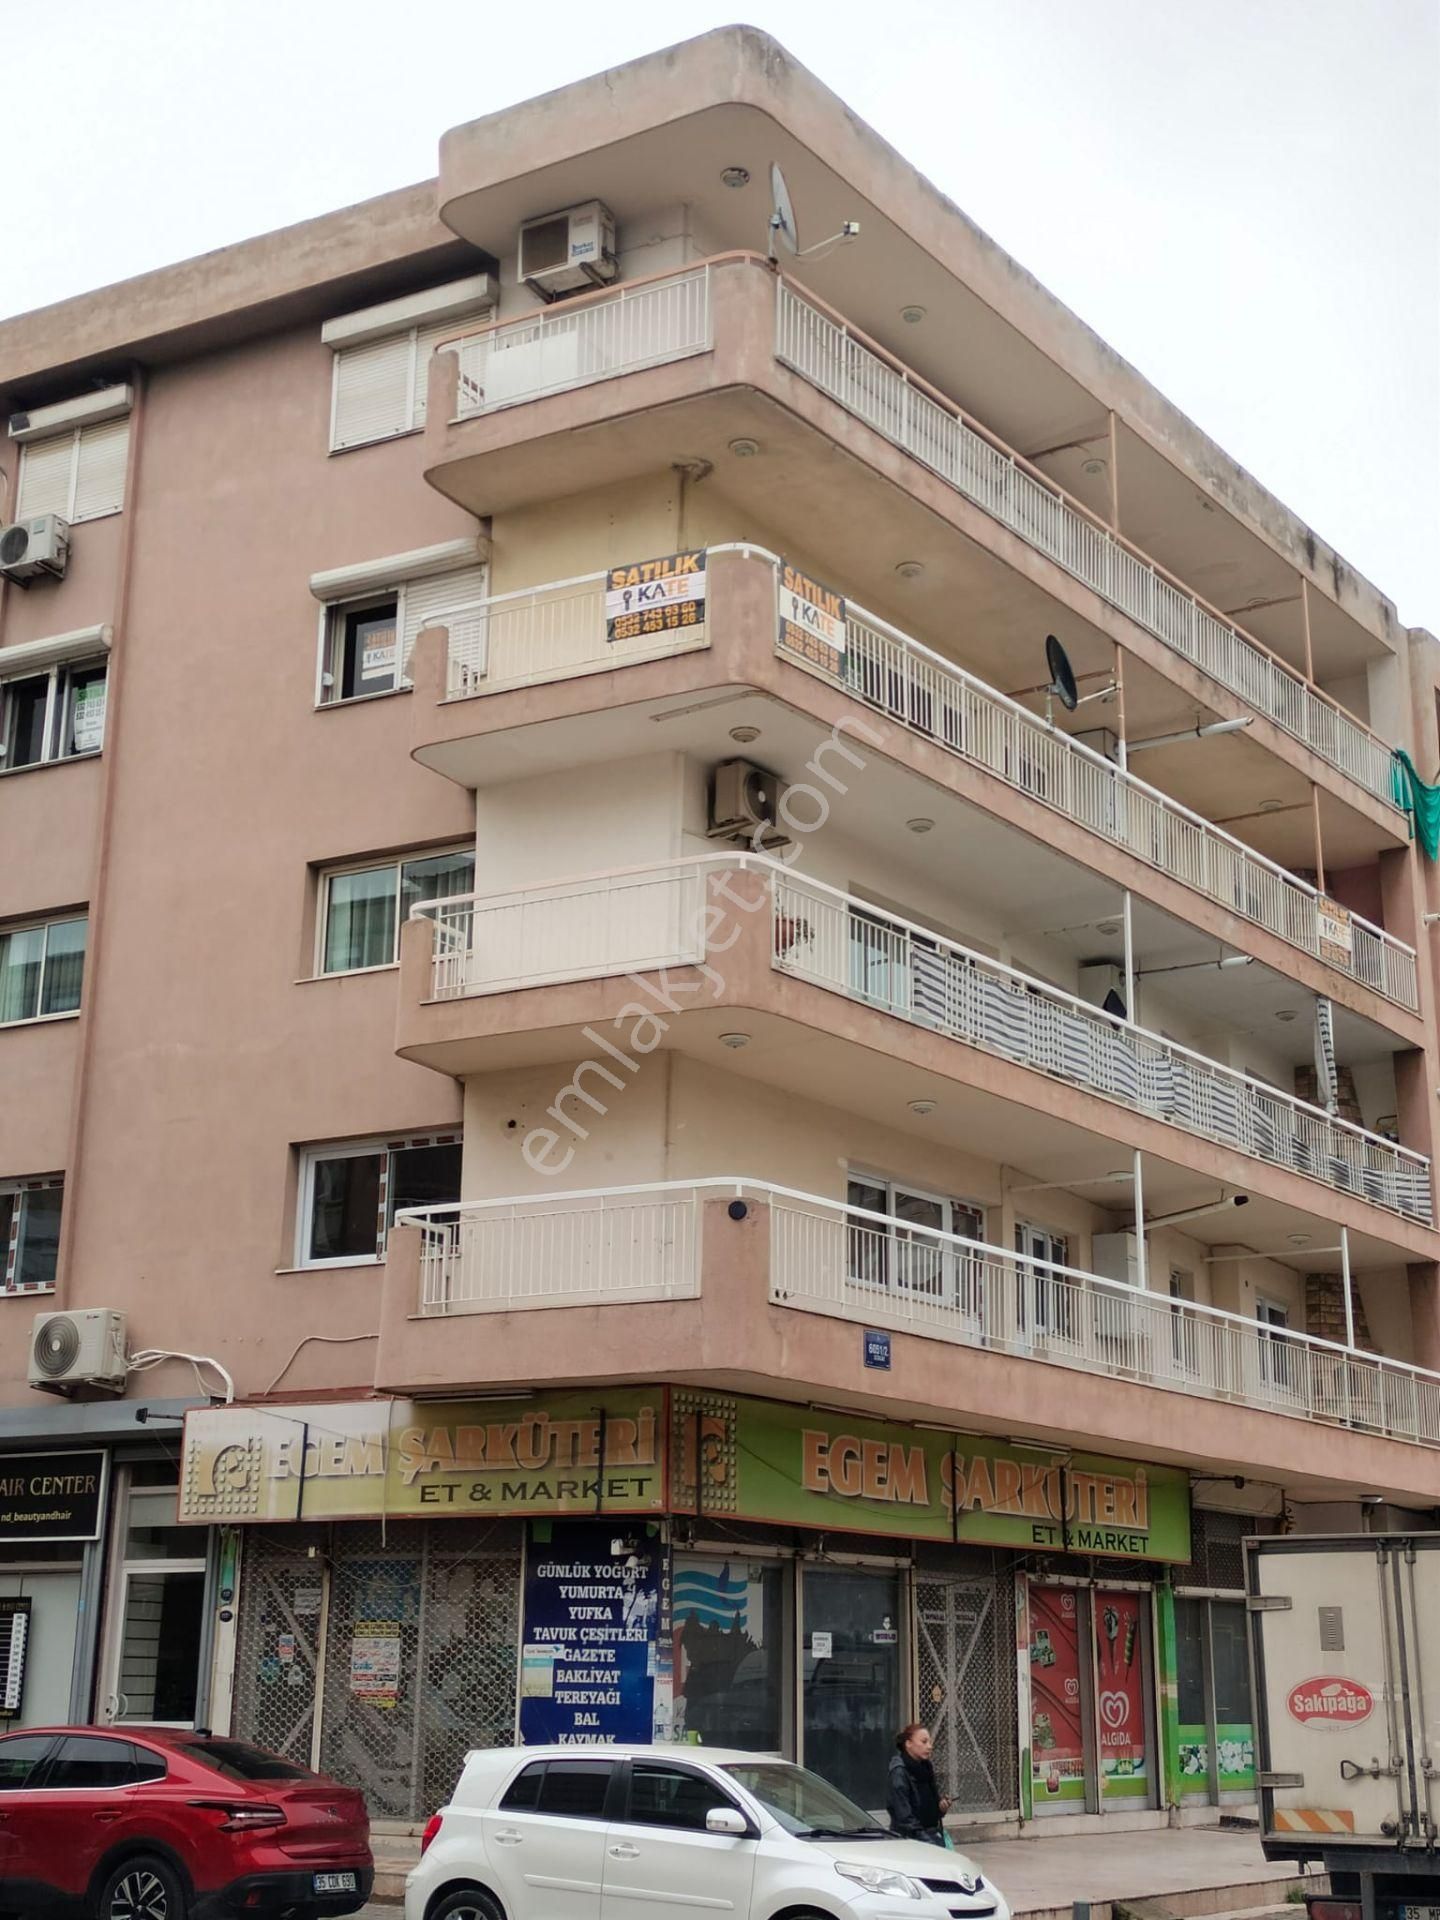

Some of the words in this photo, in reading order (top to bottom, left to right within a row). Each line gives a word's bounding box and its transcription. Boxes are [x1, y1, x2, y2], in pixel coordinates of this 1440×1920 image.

[612, 554, 699, 590] SATILIK
[638, 577, 689, 602] KATE
[784, 566, 841, 620] SATILIK
[643, 619, 663, 632] 453
[802, 603, 835, 639] KATE
[265, 1432, 385, 1479] EGEM
[397, 1407, 656, 1485] ŞARKÜTERİ
[30, 1475, 96, 1496] CENTER
[800, 1429, 929, 1507] EGEM
[939, 1454, 1149, 1530] ŞARKÜTERİ
[420, 1484, 461, 1503] ET
[469, 1482, 492, 1502] &
[501, 1477, 653, 1501] MARKET
[1, 1511, 72, 1523] nd_beautyandhair
[1032, 1525, 1056, 1544] ET
[1063, 1530, 1074, 1548] &
[1078, 1530, 1149, 1554] MARKET
[537, 1562, 590, 1578] GÜNLÜK
[594, 1562, 649, 1579] YOĞURT
[559, 1585, 624, 1600] YUMURTA
[568, 1607, 613, 1620] YUFKA
[533, 1627, 577, 1641] TAVUK
[563, 1649, 616, 1662] GAZETE
[556, 1667, 621, 1683] BAKLİYAT
[555, 1690, 621, 1705] TEREYAĞI
[574, 1713, 600, 1726] BAL
[558, 1733, 616, 1744] KAYMAK
[1407, 1907, 1420, 1920] 35
